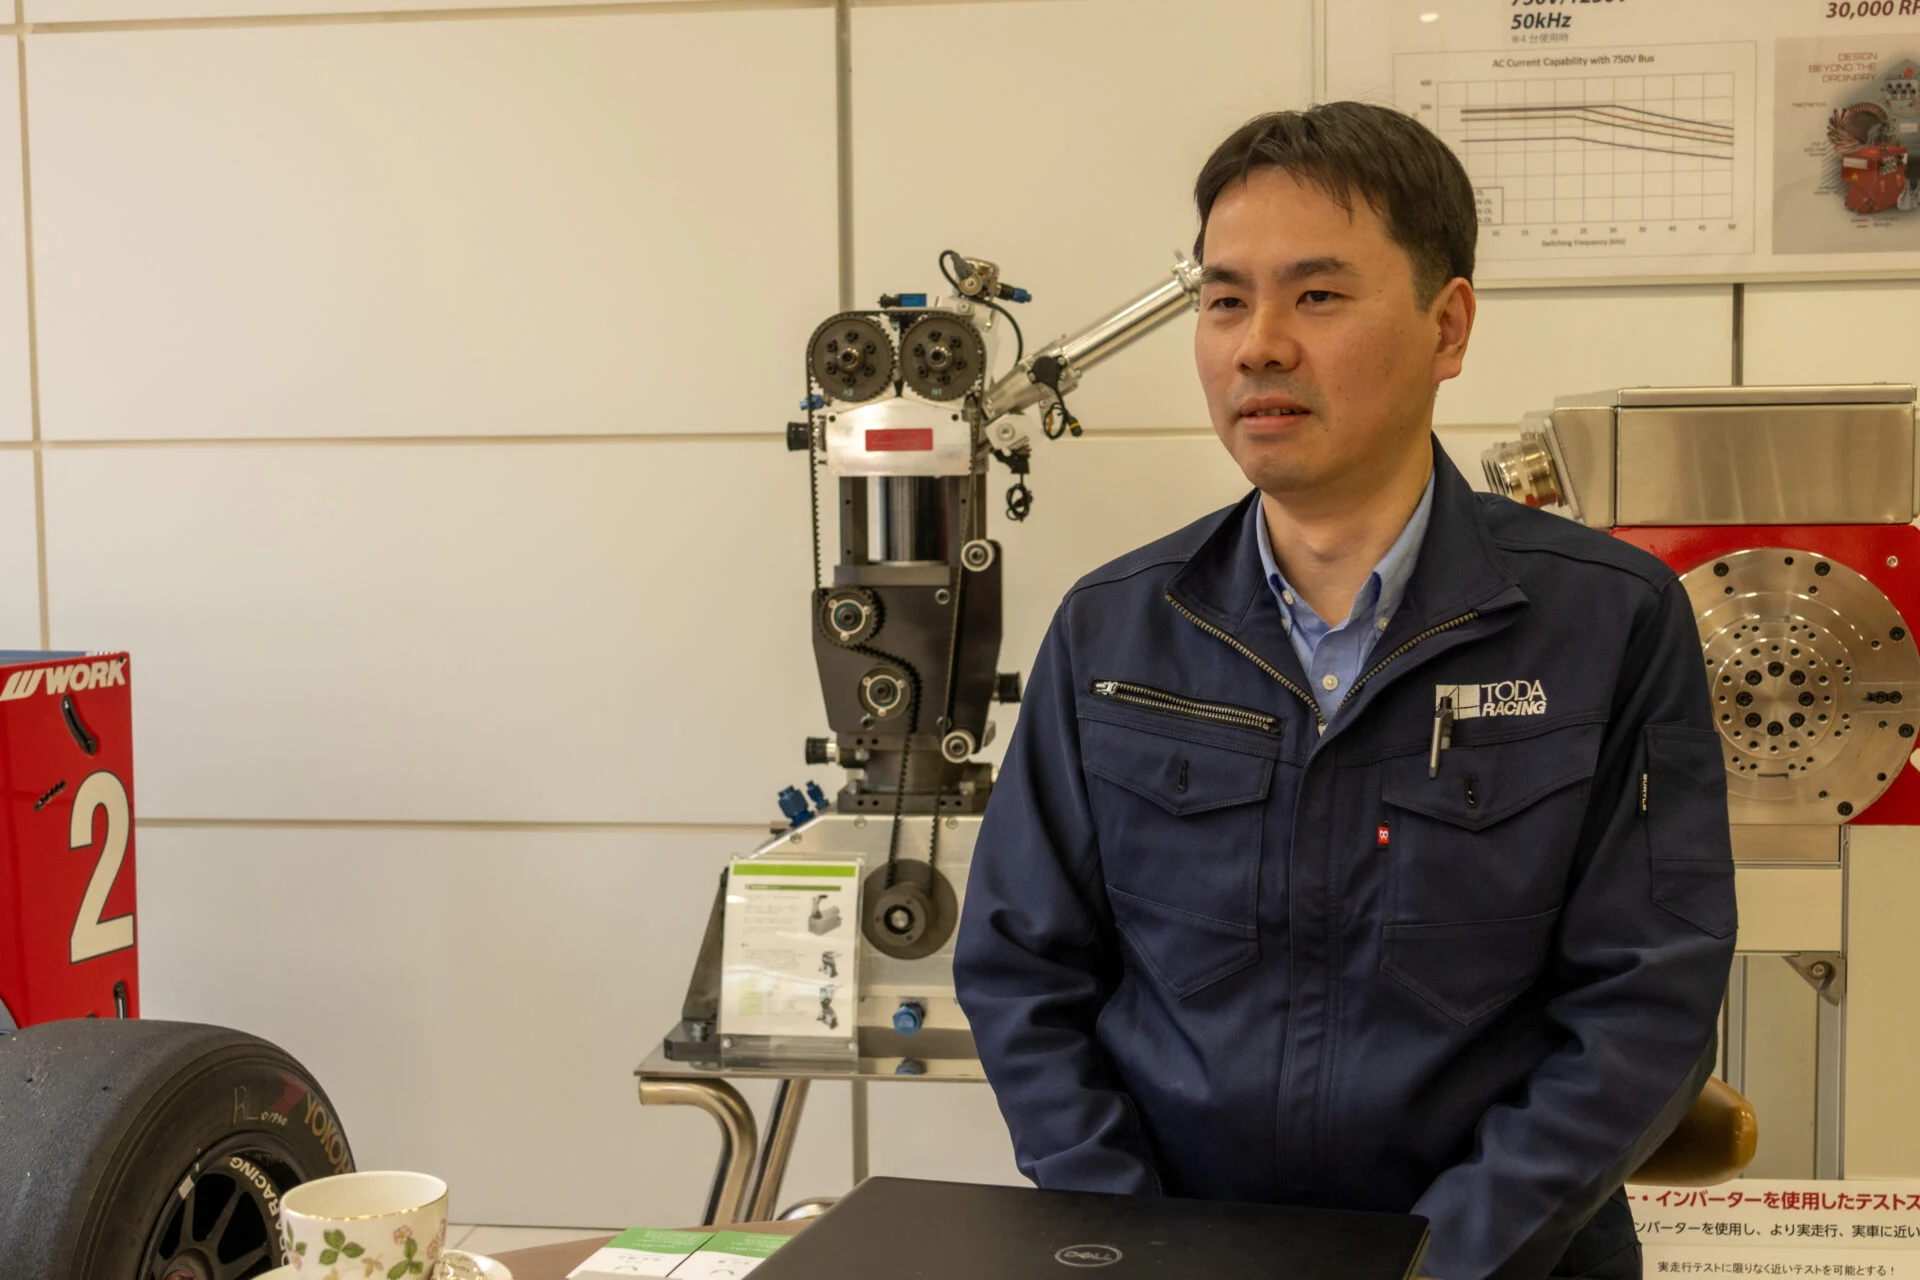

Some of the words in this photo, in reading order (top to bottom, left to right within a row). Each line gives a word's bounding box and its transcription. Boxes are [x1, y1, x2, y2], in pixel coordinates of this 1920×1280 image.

[1825, 1, 1894, 20] 30,000
[1511, 12, 1572, 30] 50kHz
[1492, 60, 1505, 68] AC
[1507, 58, 1541, 68] Current
[1543, 56, 1588, 68] Capability
[1590, 56, 1610, 65] with
[1613, 54, 1635, 65] 750V
[1638, 54, 1655, 63] Bus
[1838, 52, 1878, 61] DESIGN
[1808, 64, 1854, 73] BEYOND
[1856, 63, 1877, 71] THE
[46, 659, 127, 695] WORK
[1481, 679, 1547, 701] TODA
[1481, 700, 1547, 717] RACING
[69, 769, 135, 964] 2
[229, 1156, 281, 1217] RACING
[1063, 1250, 1112, 1261] DELL
